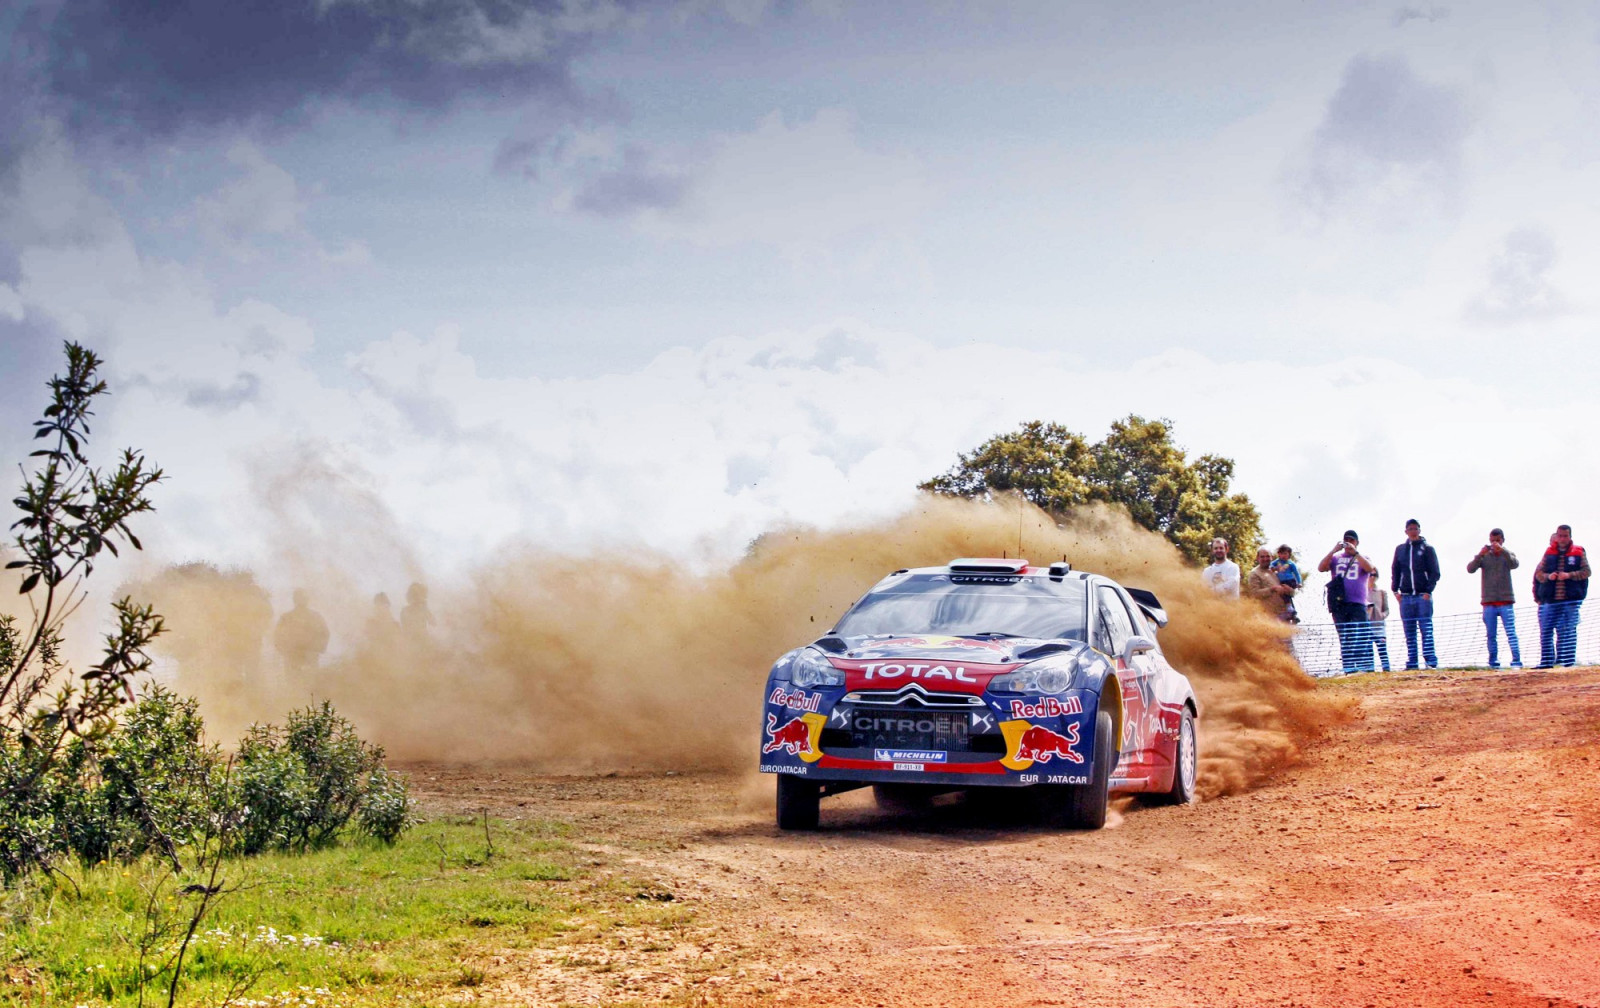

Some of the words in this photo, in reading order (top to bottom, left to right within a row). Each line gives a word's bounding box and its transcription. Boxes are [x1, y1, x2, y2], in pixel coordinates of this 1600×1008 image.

[859, 663, 977, 683] TOTAL
[892, 751, 944, 760] MICHELIN
[760, 764, 807, 775] EURODATACAR
